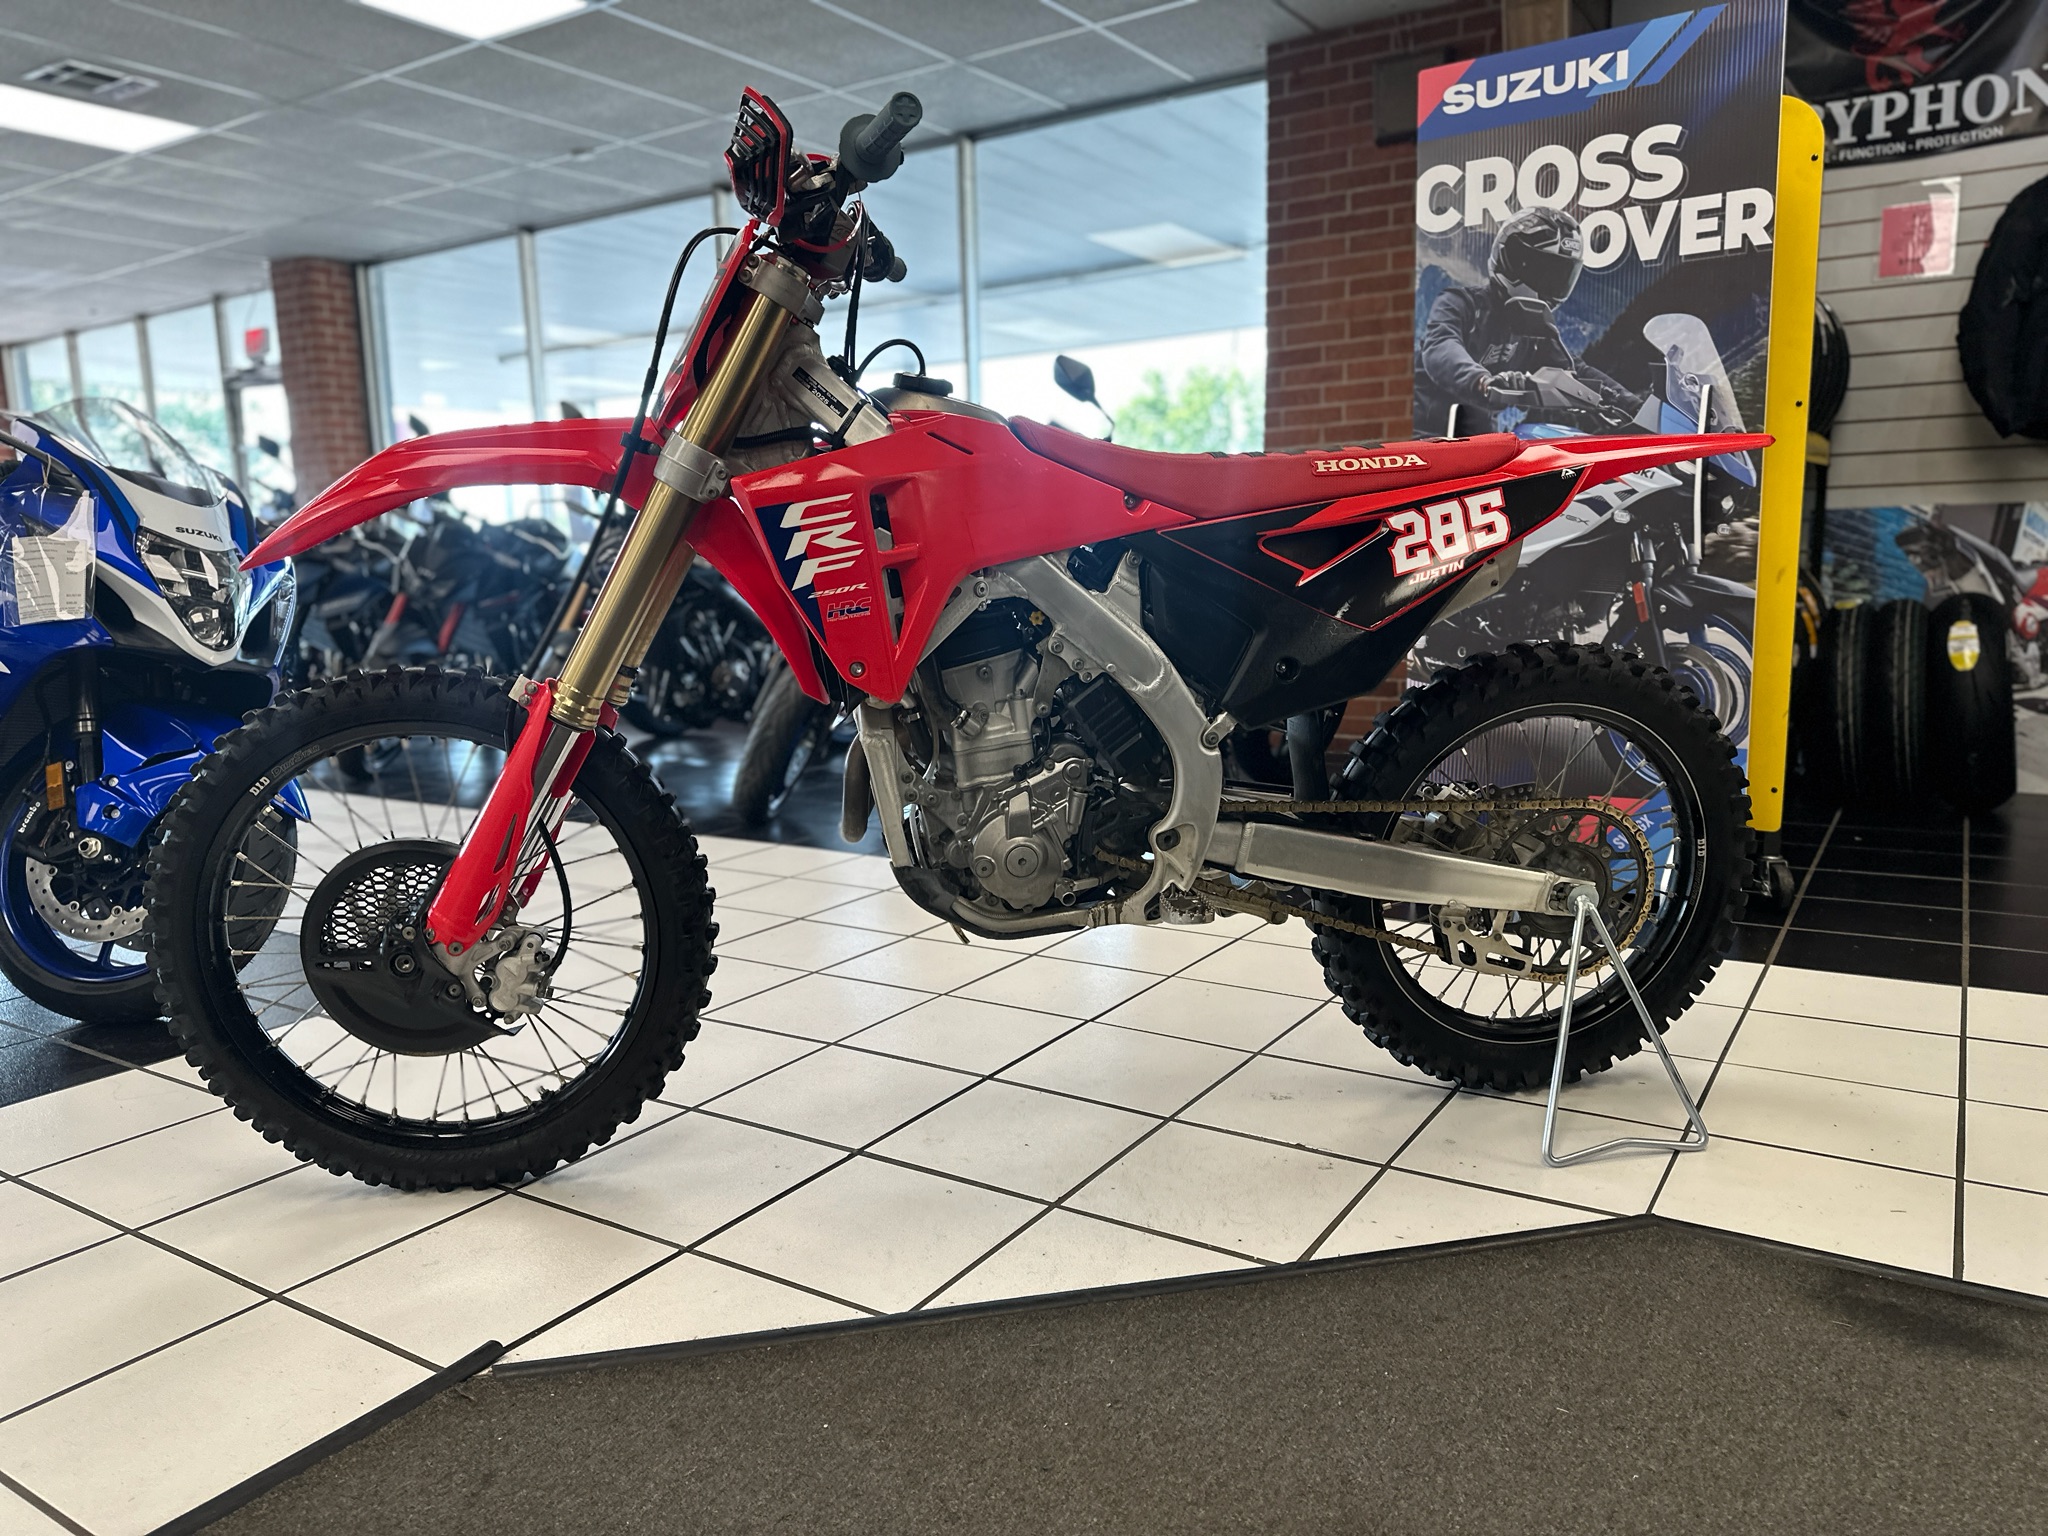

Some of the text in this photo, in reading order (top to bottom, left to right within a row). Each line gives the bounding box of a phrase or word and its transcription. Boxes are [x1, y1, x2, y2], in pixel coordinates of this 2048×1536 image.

[1443, 49, 1629, 115] SUZUKI
[1818, 63, 2048, 145] YPHON
[1839, 141, 1906, 161] FUNCTION
[1915, 125, 2004, 150] PROTECTION
[1416, 124, 1684, 233] CROSS
[1580, 187, 1774, 268] OVER
[1314, 454, 1427, 472] HONDA
[175, 526, 223, 543] SUZUKI
[780, 492, 864, 591] CRF
[1385, 487, 1511, 577] 285
[1408, 558, 1465, 586] JUSTIN
[807, 582, 869, 599] 250R
[827, 596, 871, 619] HRC
[249, 776, 271, 797] DID
[17, 801, 41, 834] brembo
[1697, 838, 1705, 857] DID
